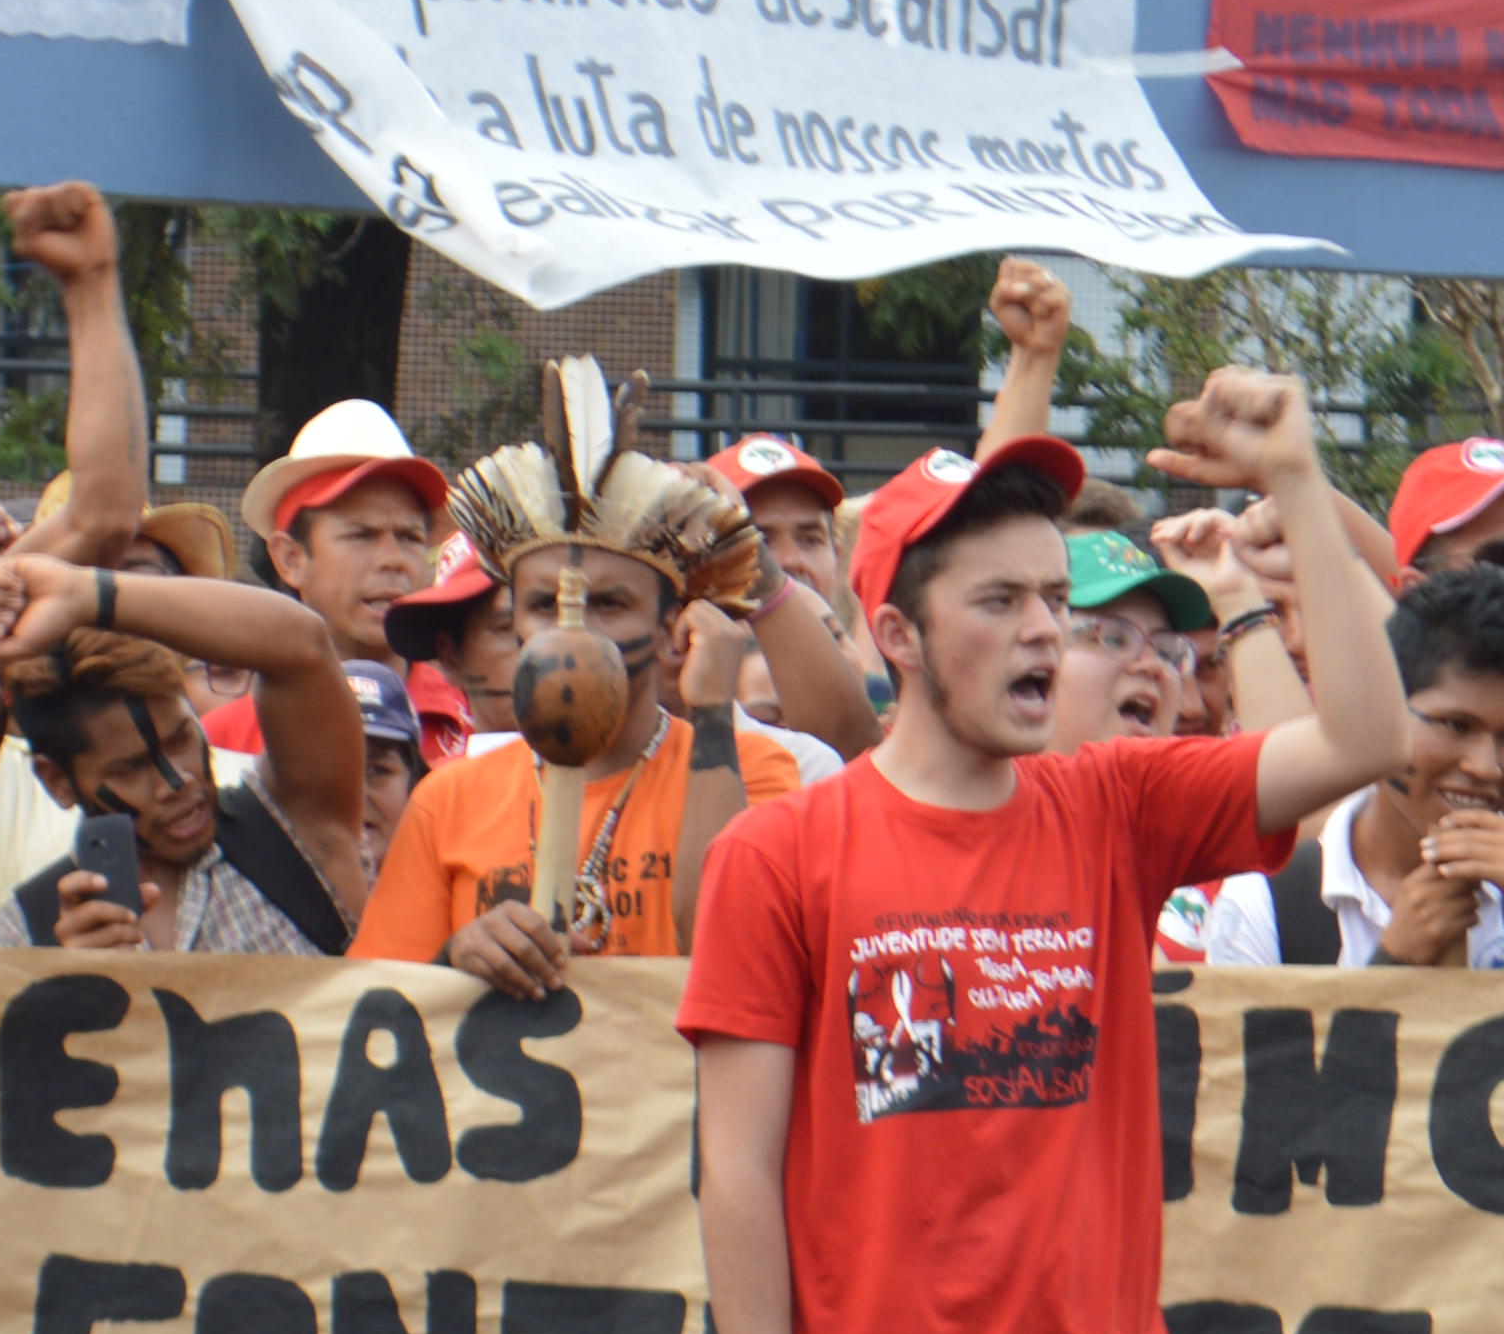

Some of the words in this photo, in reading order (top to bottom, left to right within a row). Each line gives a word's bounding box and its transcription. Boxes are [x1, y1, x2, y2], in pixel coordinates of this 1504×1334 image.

[1251, 12, 1461, 69] NENHUM
[471, 90, 524, 153] a
[534, 56, 680, 159] luta
[693, 56, 760, 164] de
[1250, 74, 1353, 128] MAS
[1367, 80, 1501, 139] TODA
[759, 185, 954, 241] POR
[850, 926, 967, 963] JUVENTUDE
[969, 927, 1009, 954] SEM
[1010, 927, 1067, 955] TERRA
